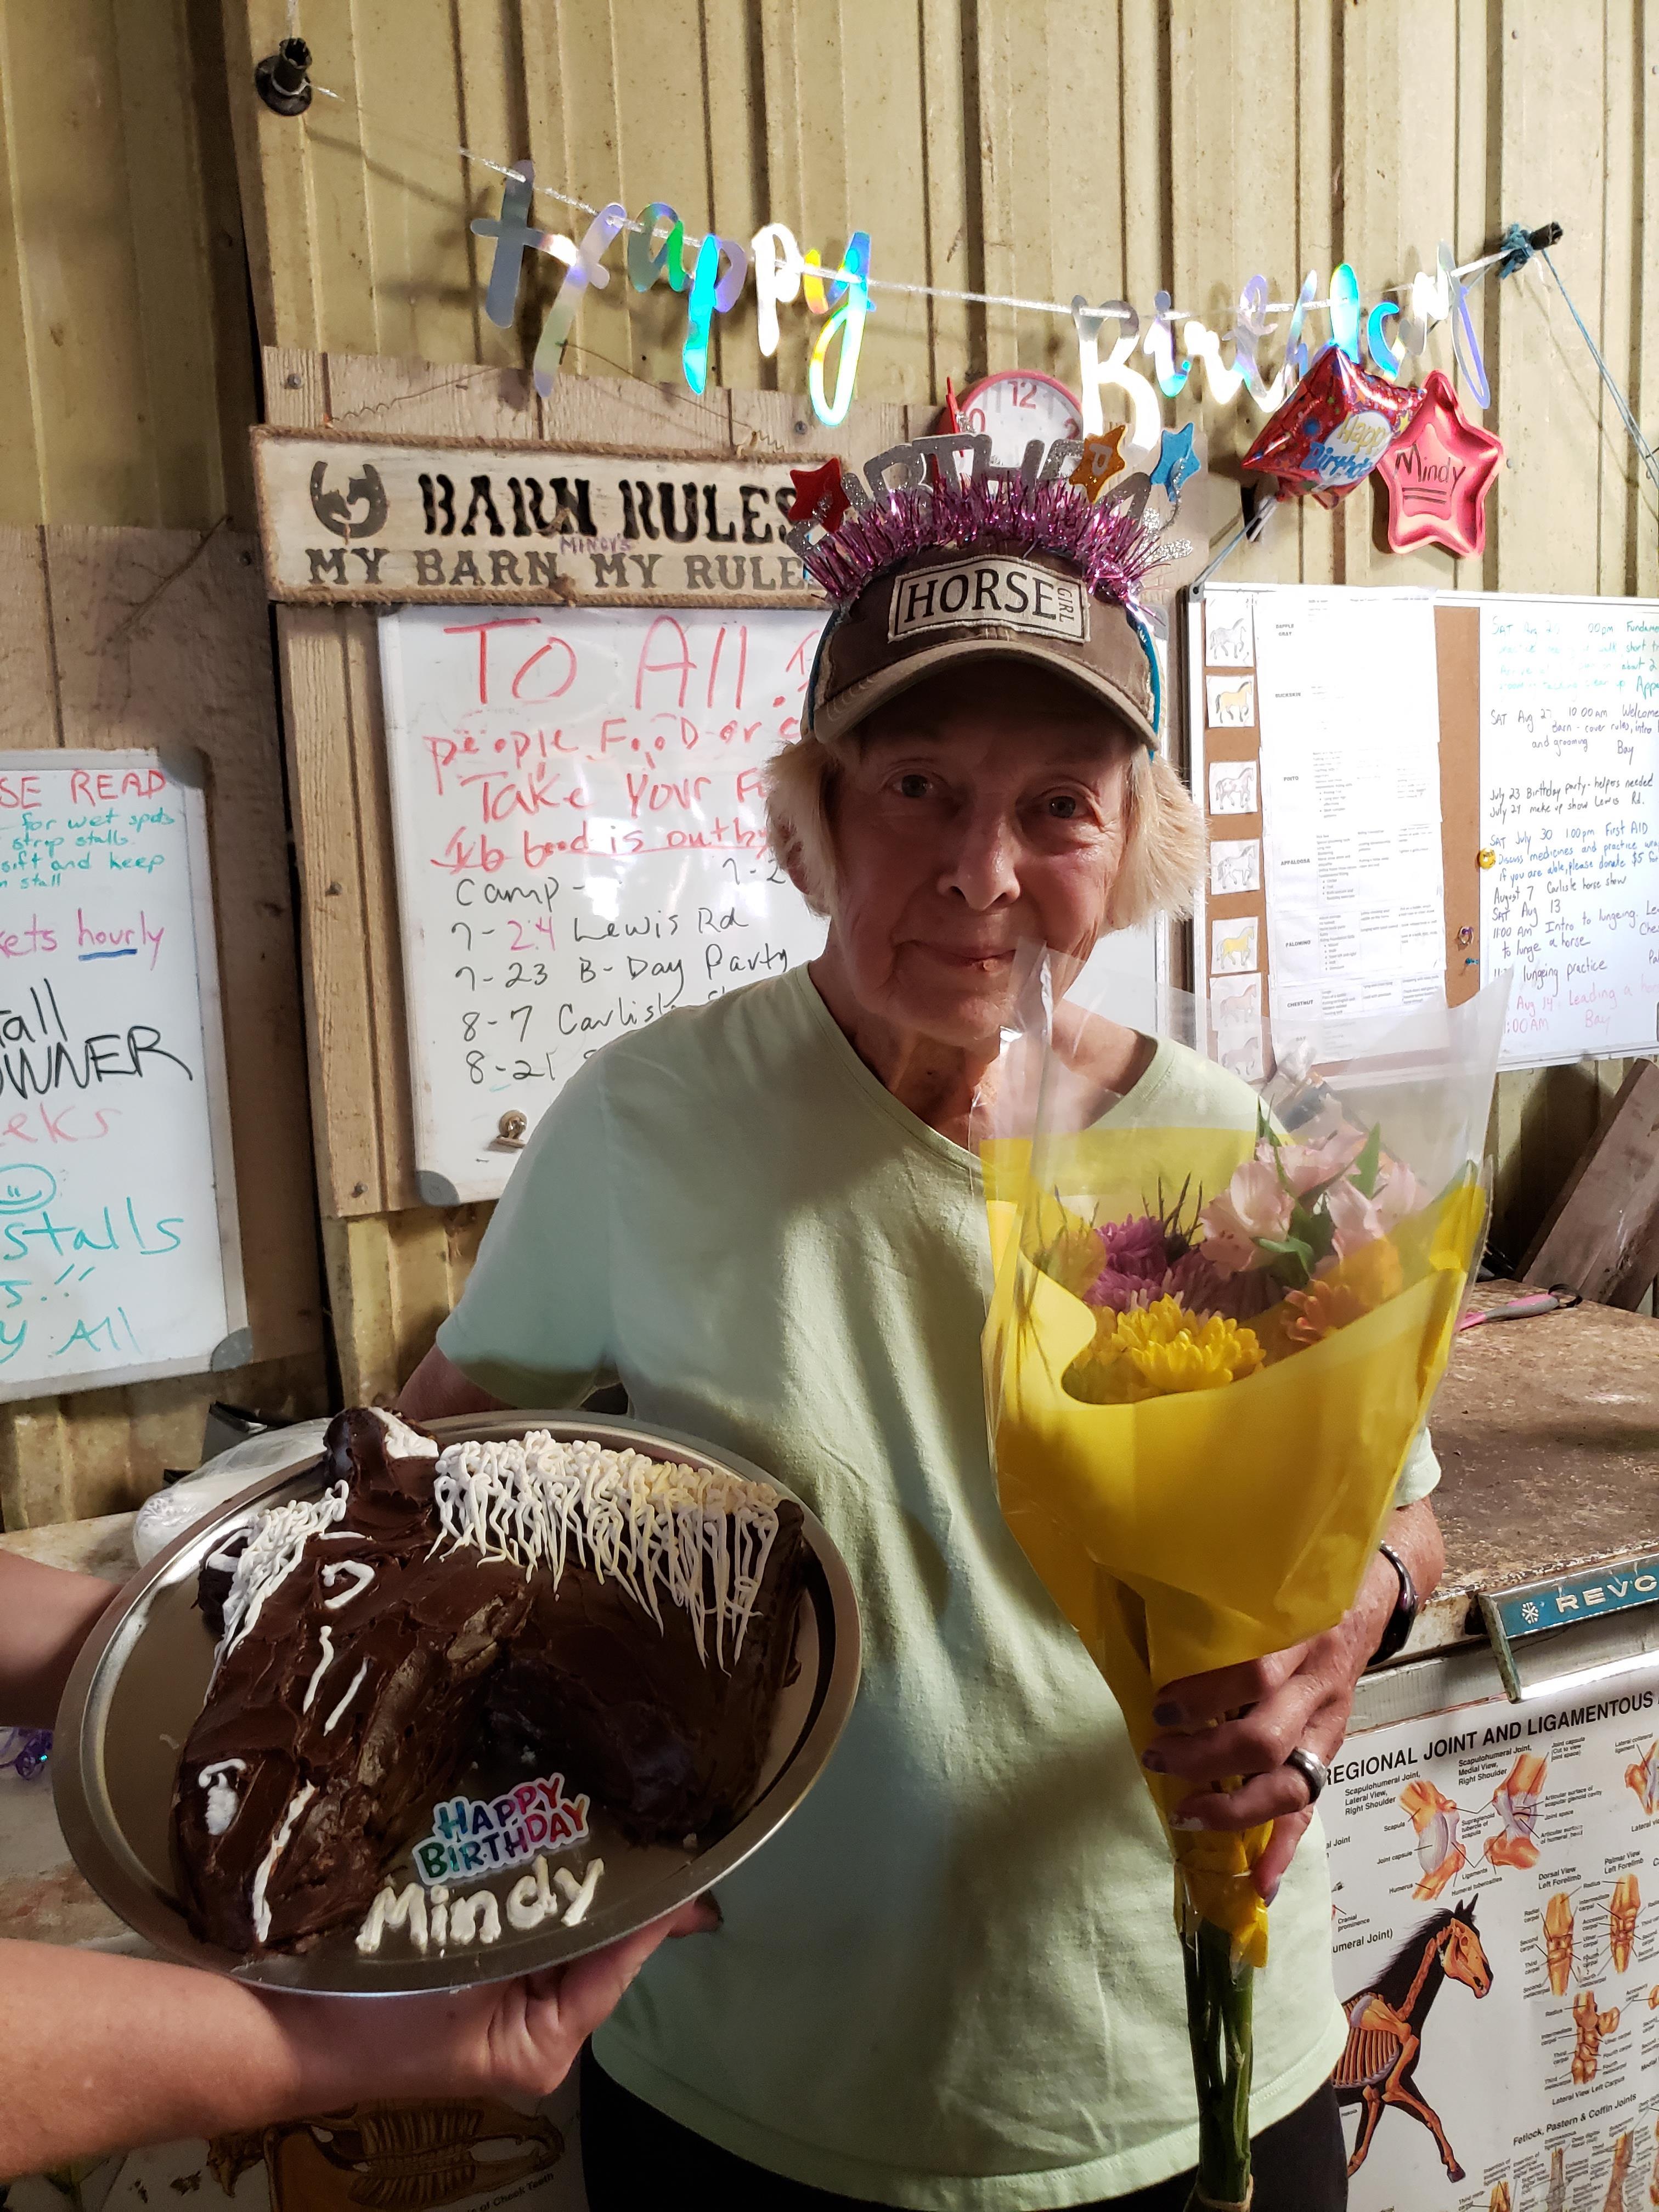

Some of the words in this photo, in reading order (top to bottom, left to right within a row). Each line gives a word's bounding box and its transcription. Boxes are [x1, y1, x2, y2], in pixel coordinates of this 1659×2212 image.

[1007, 380, 1036, 409] 12
[1395, 442, 1466, 496] Mindy
[417, 473, 598, 537] BARN
[307, 550, 390, 587] MY
[415, 549, 564, 587] BARN
[594, 553, 663, 589] MY
[685, 554, 817, 591] RULE
[904, 568, 1057, 623] HORSE
[1057, 588, 1074, 622] GIRL
[443, 617, 578, 706] TO
[1491, 709, 1507, 726] SAT
[1518, 710, 1533, 733] Aug
[1585, 724, 1605, 733] cover
[1635, 721, 1652, 734] intro
[1532, 735, 1549, 748] and
[1554, 739, 1588, 757] grooming
[1617, 740, 1634, 765] Bay
[70, 768, 167, 807] READ
[1490, 788, 1504, 807] July
[1509, 788, 1520, 800] 23
[1527, 780, 1561, 802] Birthday
[1594, 776, 1620, 794] helpers
[1625, 773, 1654, 788] needed
[68, 808, 120, 829] wet
[1490, 803, 1507, 825] July
[1567, 798, 1588, 810] show
[1594, 795, 1619, 807] Lewis
[610, 825, 644, 854] is
[1490, 834, 1506, 849] SAT
[1516, 831, 1531, 855] July
[1540, 828, 1553, 840] 30
[1606, 820, 1625, 837] First
[1631, 821, 1648, 835] AID
[51, 851, 91, 871] and
[110, 851, 165, 874] keep
[1499, 854, 1523, 865] Discuss
[1530, 846, 1573, 861] medicines
[1582, 841, 1596, 853] and
[1604, 839, 1637, 856] practice
[20, 873, 61, 889] stall
[1510, 872, 1525, 887] you
[1568, 859, 1593, 876] please
[1599, 855, 1626, 869] donate
[1632, 851, 1644, 867] $5
[456, 877, 560, 912] Camp
[1494, 886, 1520, 910] August
[1527, 886, 1534, 901] 7
[1583, 878, 1601, 890] horse
[1606, 872, 1627, 886] show
[574, 911, 679, 942] Lewis
[698, 907, 749, 933] Rd
[1492, 909, 1510, 922] SAT
[1522, 901, 1538, 927] Aug
[1550, 899, 1561, 913] 13
[1493, 927, 1512, 939] 11:00
[1517, 926, 1532, 938] AM
[1545, 917, 1574, 933] Intro
[1583, 911, 1591, 926] to
[78, 907, 165, 971] hourly
[1503, 941, 1511, 959] to
[1517, 939, 1541, 962] lunge
[1549, 939, 1558, 947] a
[1561, 932, 1591, 947] horse
[455, 962, 549, 991] 7-23
[706, 943, 788, 980] Party
[1567, 957, 1608, 981] practice
[1287, 1000, 1314, 1008] CHESTNUT
[1516, 996, 1536, 1018] Aug
[1543, 997, 1553, 1011] 14
[1570, 982, 1617, 1009] Leading
[462, 1006, 534, 1043] 8-7
[1585, 1009, 1610, 1035] Bay
[0, 1025, 193, 1099] WNER
[466, 1051, 557, 1084] 8-21
[55, 1307, 142, 1355] All
[1424, 1731, 1477, 1760] JOINT
[1483, 1722, 1521, 1746] AND
[1527, 1691, 1653, 1736] LIGAMENTOUS
[1458, 1748, 1512, 1767] Scapulohumeral
[1513, 1744, 1532, 1754] Joint,
[1458, 1765, 1480, 1776] Medial
[1481, 1762, 1498, 1770] View,
[1345, 1775, 1400, 1797] Scapulohumeral
[1402, 1770, 1421, 1782] Joint,
[1458, 1774, 1476, 1785] Right
[1478, 1768, 1507, 1781] Shoulder
[438, 1777, 560, 1839] HAPPY
[1345, 1793, 1368, 1805] Lateral
[1371, 1790, 1388, 1801] View,
[1345, 1803, 1363, 1815] Right
[1365, 1796, 1396, 1810] Shoulder
[418, 1798, 587, 1878] BIRTHDAY
[1384, 1821, 1405, 1832] Scapula
[1461, 1830, 1481, 1839] scapula
[1631, 1824, 1651, 1832] Lateral
[1333, 1836, 1351, 1847] Joint
[1377, 1857, 1390, 1865] Joint
[1392, 1850, 1413, 1861] capsule
[1604, 1865, 1616, 1874] Left
[1538, 1870, 1559, 1881] Dorsal
[1561, 1866, 1576, 1875] View
[1538, 1880, 1551, 1889] Left
[1553, 1875, 1581, 1885] Forelimb
[355, 1854, 604, 1954] Mindy
[1338, 1914, 1357, 1925] Cranial
[1338, 1918, 1370, 1932] prominence
[1367, 1928, 1393, 1944] Joint)
[1551, 2092, 1574, 2105] Lateral
[1575, 2089, 1590, 2099] View
[1513, 2128, 1544, 2146] Fetlock,
[1547, 2117, 1578, 2132] Pastern
[1580, 2112, 1586, 2121] &
[1588, 2104, 1612, 2119] Coffin
[1615, 2094, 1637, 2109] Joints
